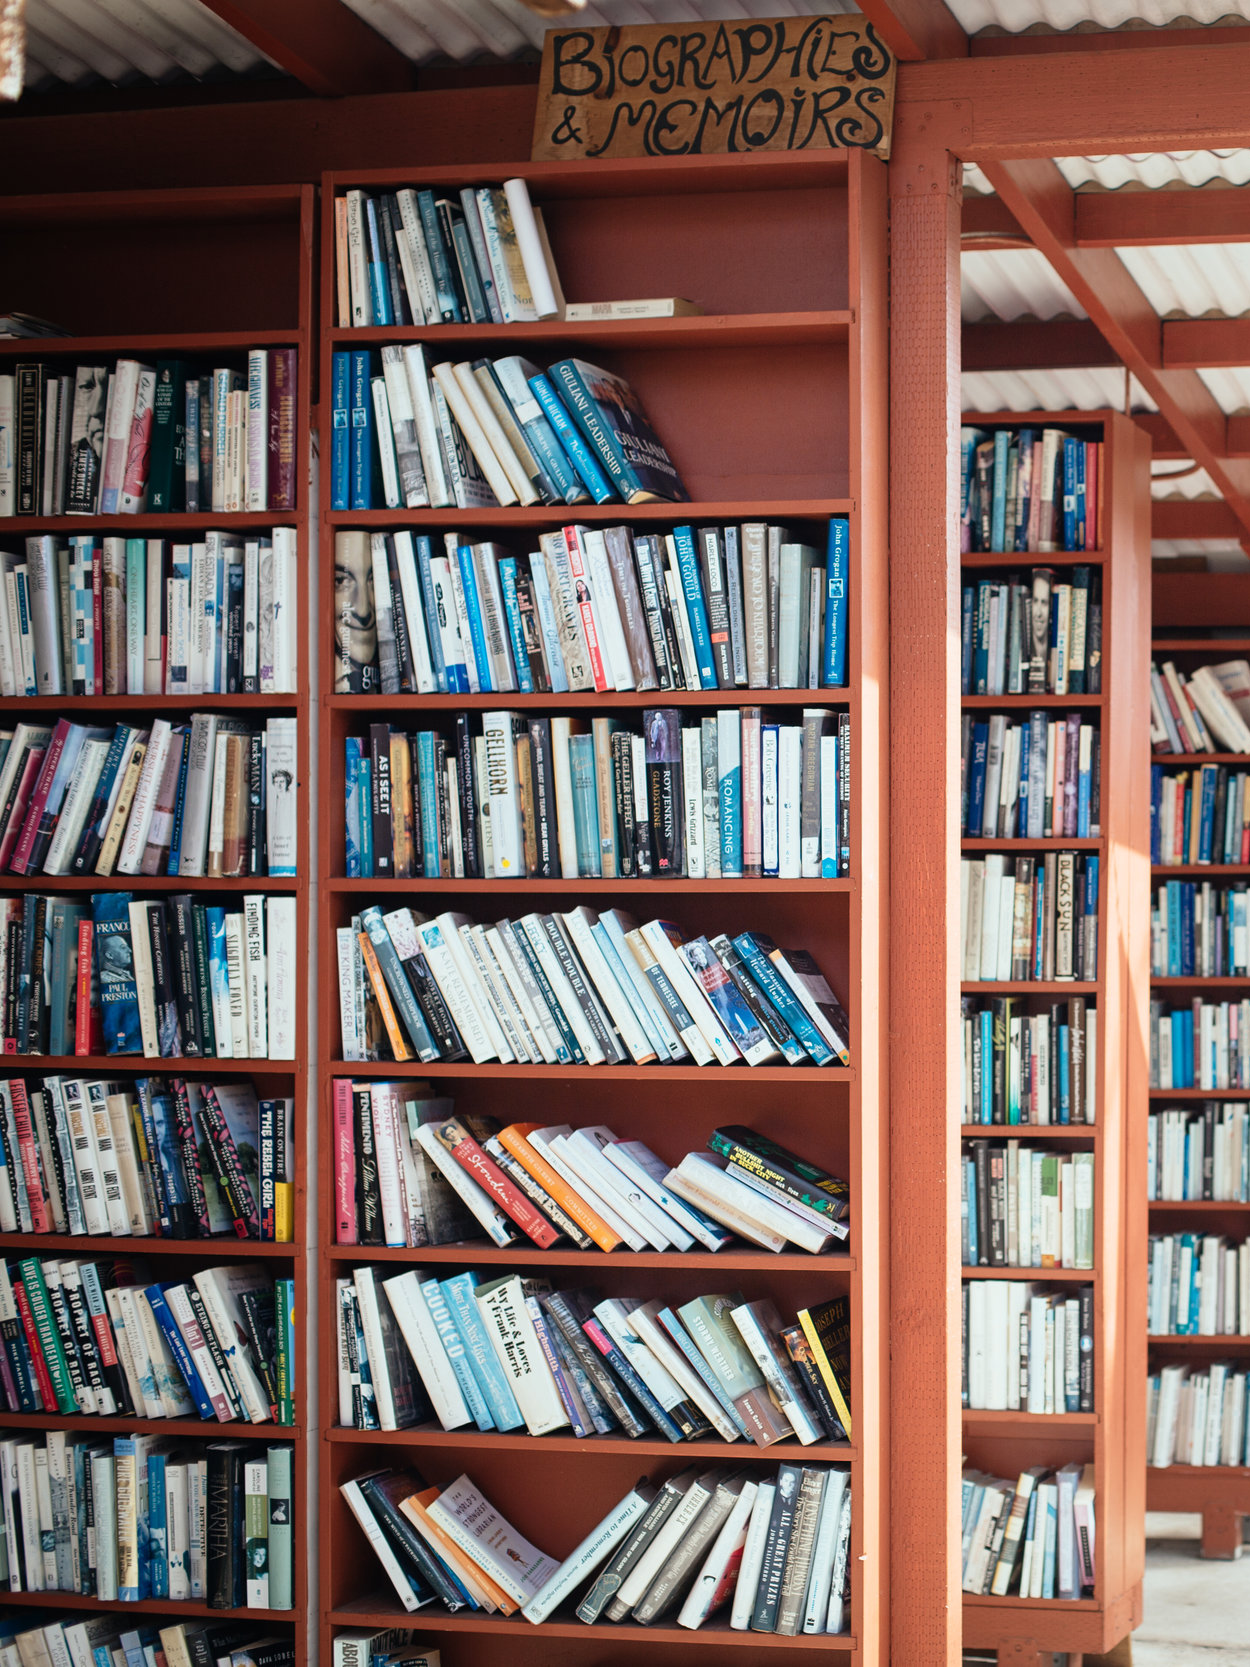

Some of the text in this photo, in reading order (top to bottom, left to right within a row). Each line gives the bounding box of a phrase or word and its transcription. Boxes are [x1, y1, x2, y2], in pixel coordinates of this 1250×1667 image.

[552, 105, 583, 144] &
[216, 373, 228, 457] GERALD DURRELL
[336, 379, 345, 408] Grogan
[355, 378, 363, 407] Grogan
[534, 379, 567, 430] HOMER HICKAM
[559, 365, 621, 475] GIULIANI LEADERSHIP
[419, 541, 435, 615] MULTIPLE BLESSINGS
[677, 535, 696, 601] JOHN GOULD
[707, 538, 718, 587] HARLEY LOCO
[833, 547, 842, 577] Grogan
[341, 601, 355, 625] alec
[552, 537, 579, 642] ROBERT GRAVES
[232, 605, 240, 630] Rupert
[647, 610, 667, 667] FRANKLIN GRAHAM
[338, 626, 353, 675] guinness
[111, 727, 128, 768] RUPERT
[379, 755, 388, 771] AS
[462, 735, 472, 787] UNCOMMON
[486, 729, 508, 796] GELLHORN
[380, 780, 389, 802] SEE
[621, 737, 632, 829] THE GELLER EFFECT
[652, 771, 660, 828] GLADSTONE
[766, 758, 774, 791] Greene
[127, 795, 148, 856] HAPPYNESS
[380, 804, 389, 815] IT
[662, 770, 672, 838] ROY JENKINS
[689, 799, 697, 846] Lewis Grizzard
[724, 779, 733, 854] ROMANCING
[466, 828, 474, 861] CHARLES
[640, 822, 648, 843] Nights
[177, 904, 185, 935] DOSSIER
[1060, 860, 1071, 931] BLACK SUN
[81, 925, 89, 974] finding fish
[246, 903, 260, 961] FINDING FISH
[226, 934, 242, 1017] SLIGHTLY FOXED
[546, 922, 586, 997] DOUBLE DOUBLE
[750, 959, 785, 1009] Howard Hughes
[101, 991, 137, 1001] PRESTON
[341, 956, 353, 1028] KING MAKER
[426, 977, 452, 1034] ROBERT HOOKE
[650, 967, 678, 1009] OF TENNESSEE
[10, 1083, 31, 1141] FOSTER CHILD
[139, 1086, 154, 1145] ALEXANDRA FULLER
[359, 1093, 372, 1154] PENTIMENTO
[372, 1098, 381, 1137] VIOLET
[383, 1094, 392, 1138] SYDNEY
[261, 1111, 273, 1208] THE REBEL GIRL
[277, 1139, 284, 1151] ON
[733, 1146, 763, 1165] ANOTHER
[735, 1152, 785, 1183] BULLSHIT NIGHT
[79, 1168, 97, 1200] LARRY FLYNT
[103, 1169, 121, 1202] LARRY FLYNT
[361, 1158, 378, 1232] Lillian Hellman
[21, 1261, 61, 1372] LOVE IS COLDER THAN DEATH
[51, 1286, 85, 1391] PROPHET OF RAGE
[67, 1286, 103, 1391] PROPHET OF RAGE
[423, 1283, 465, 1359] COOKED
[503, 1306, 518, 1327] Life
[511, 1330, 522, 1340] &
[492, 1306, 522, 1378] Frank Harris
[514, 1341, 533, 1375] Loves
[532, 1319, 559, 1372] Highsmith
[692, 1316, 735, 1382] STORMY WEATHER
[10, 1343, 26, 1394] MIKE FARRELL
[116, 1459, 132, 1543] PURE GOLDWATER
[209, 1485, 228, 1561] MARTHA
[617, 1507, 634, 1524] Time
[780, 1510, 792, 1527] ALL
[580, 1531, 612, 1565] Remember
[761, 1546, 773, 1582] TALIAFERRO
[772, 1539, 786, 1567] GREAT
[781, 1497, 803, 1596] The Story She Could Never Tell
[790, 1498, 821, 1598] JOSEPHINE HERBST
[766, 1571, 780, 1605] PRIZES
